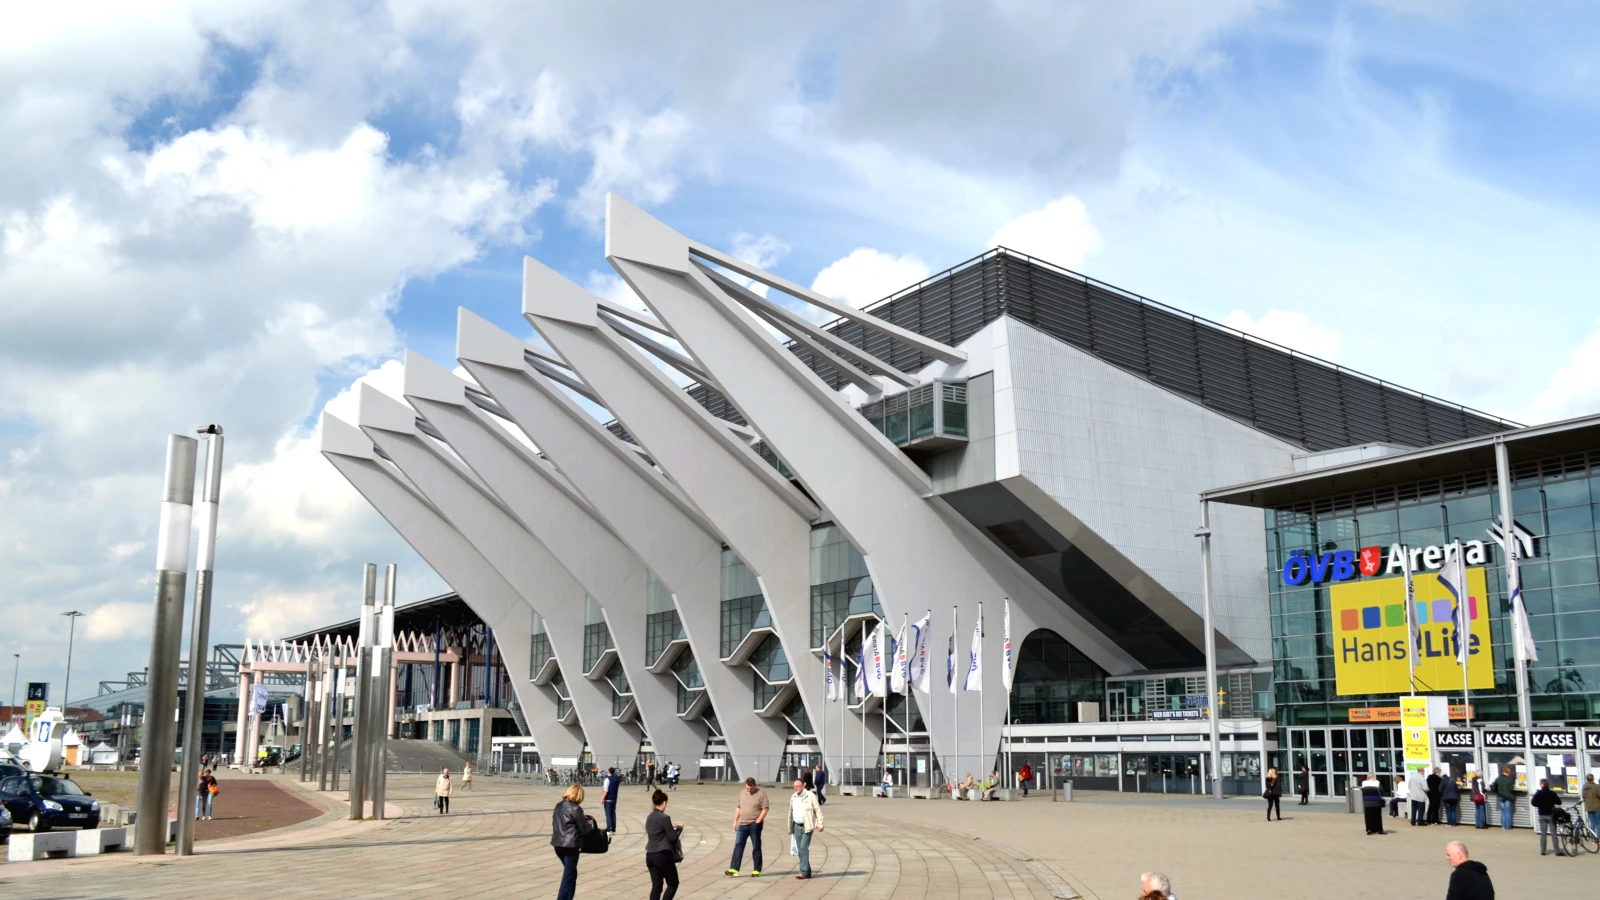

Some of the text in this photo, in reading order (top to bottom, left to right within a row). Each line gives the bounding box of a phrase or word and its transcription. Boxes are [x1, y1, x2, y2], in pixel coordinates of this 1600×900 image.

[1283, 548, 1356, 586] ÖVB
[35, 688, 42, 697] 4
[1437, 733, 1472, 745] KASSE
[1486, 733, 1523, 745] KASSE
[1532, 734, 1574, 747] KASSE
[1588, 734, 1600, 747] K
